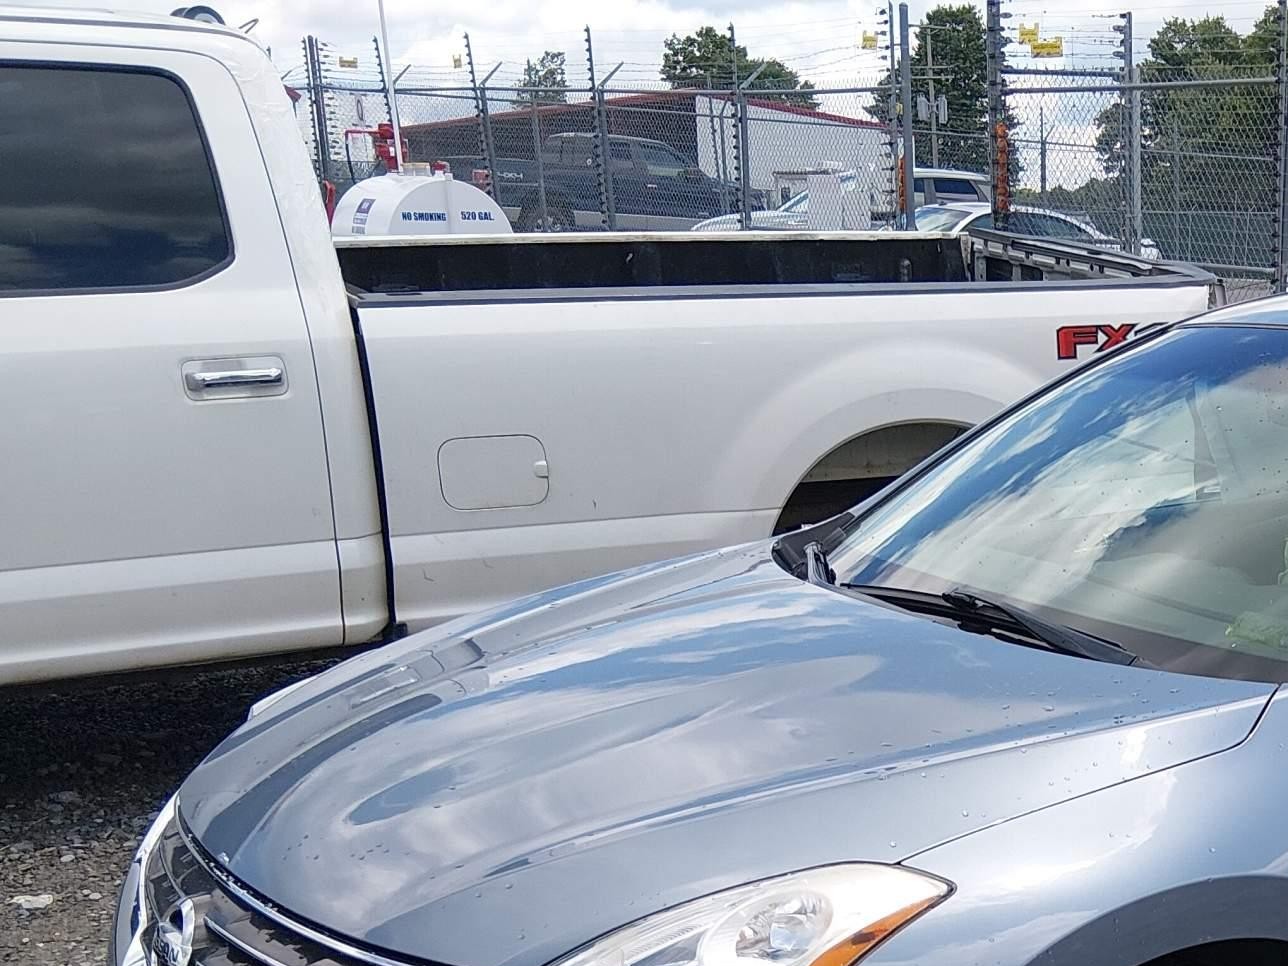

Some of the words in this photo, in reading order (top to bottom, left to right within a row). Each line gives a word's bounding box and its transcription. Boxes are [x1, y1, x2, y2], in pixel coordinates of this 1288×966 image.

[401, 211, 412, 221] NO
[413, 212, 447, 221] SMOKING
[460, 211, 477, 220] 520
[478, 211, 495, 221] GAL.
